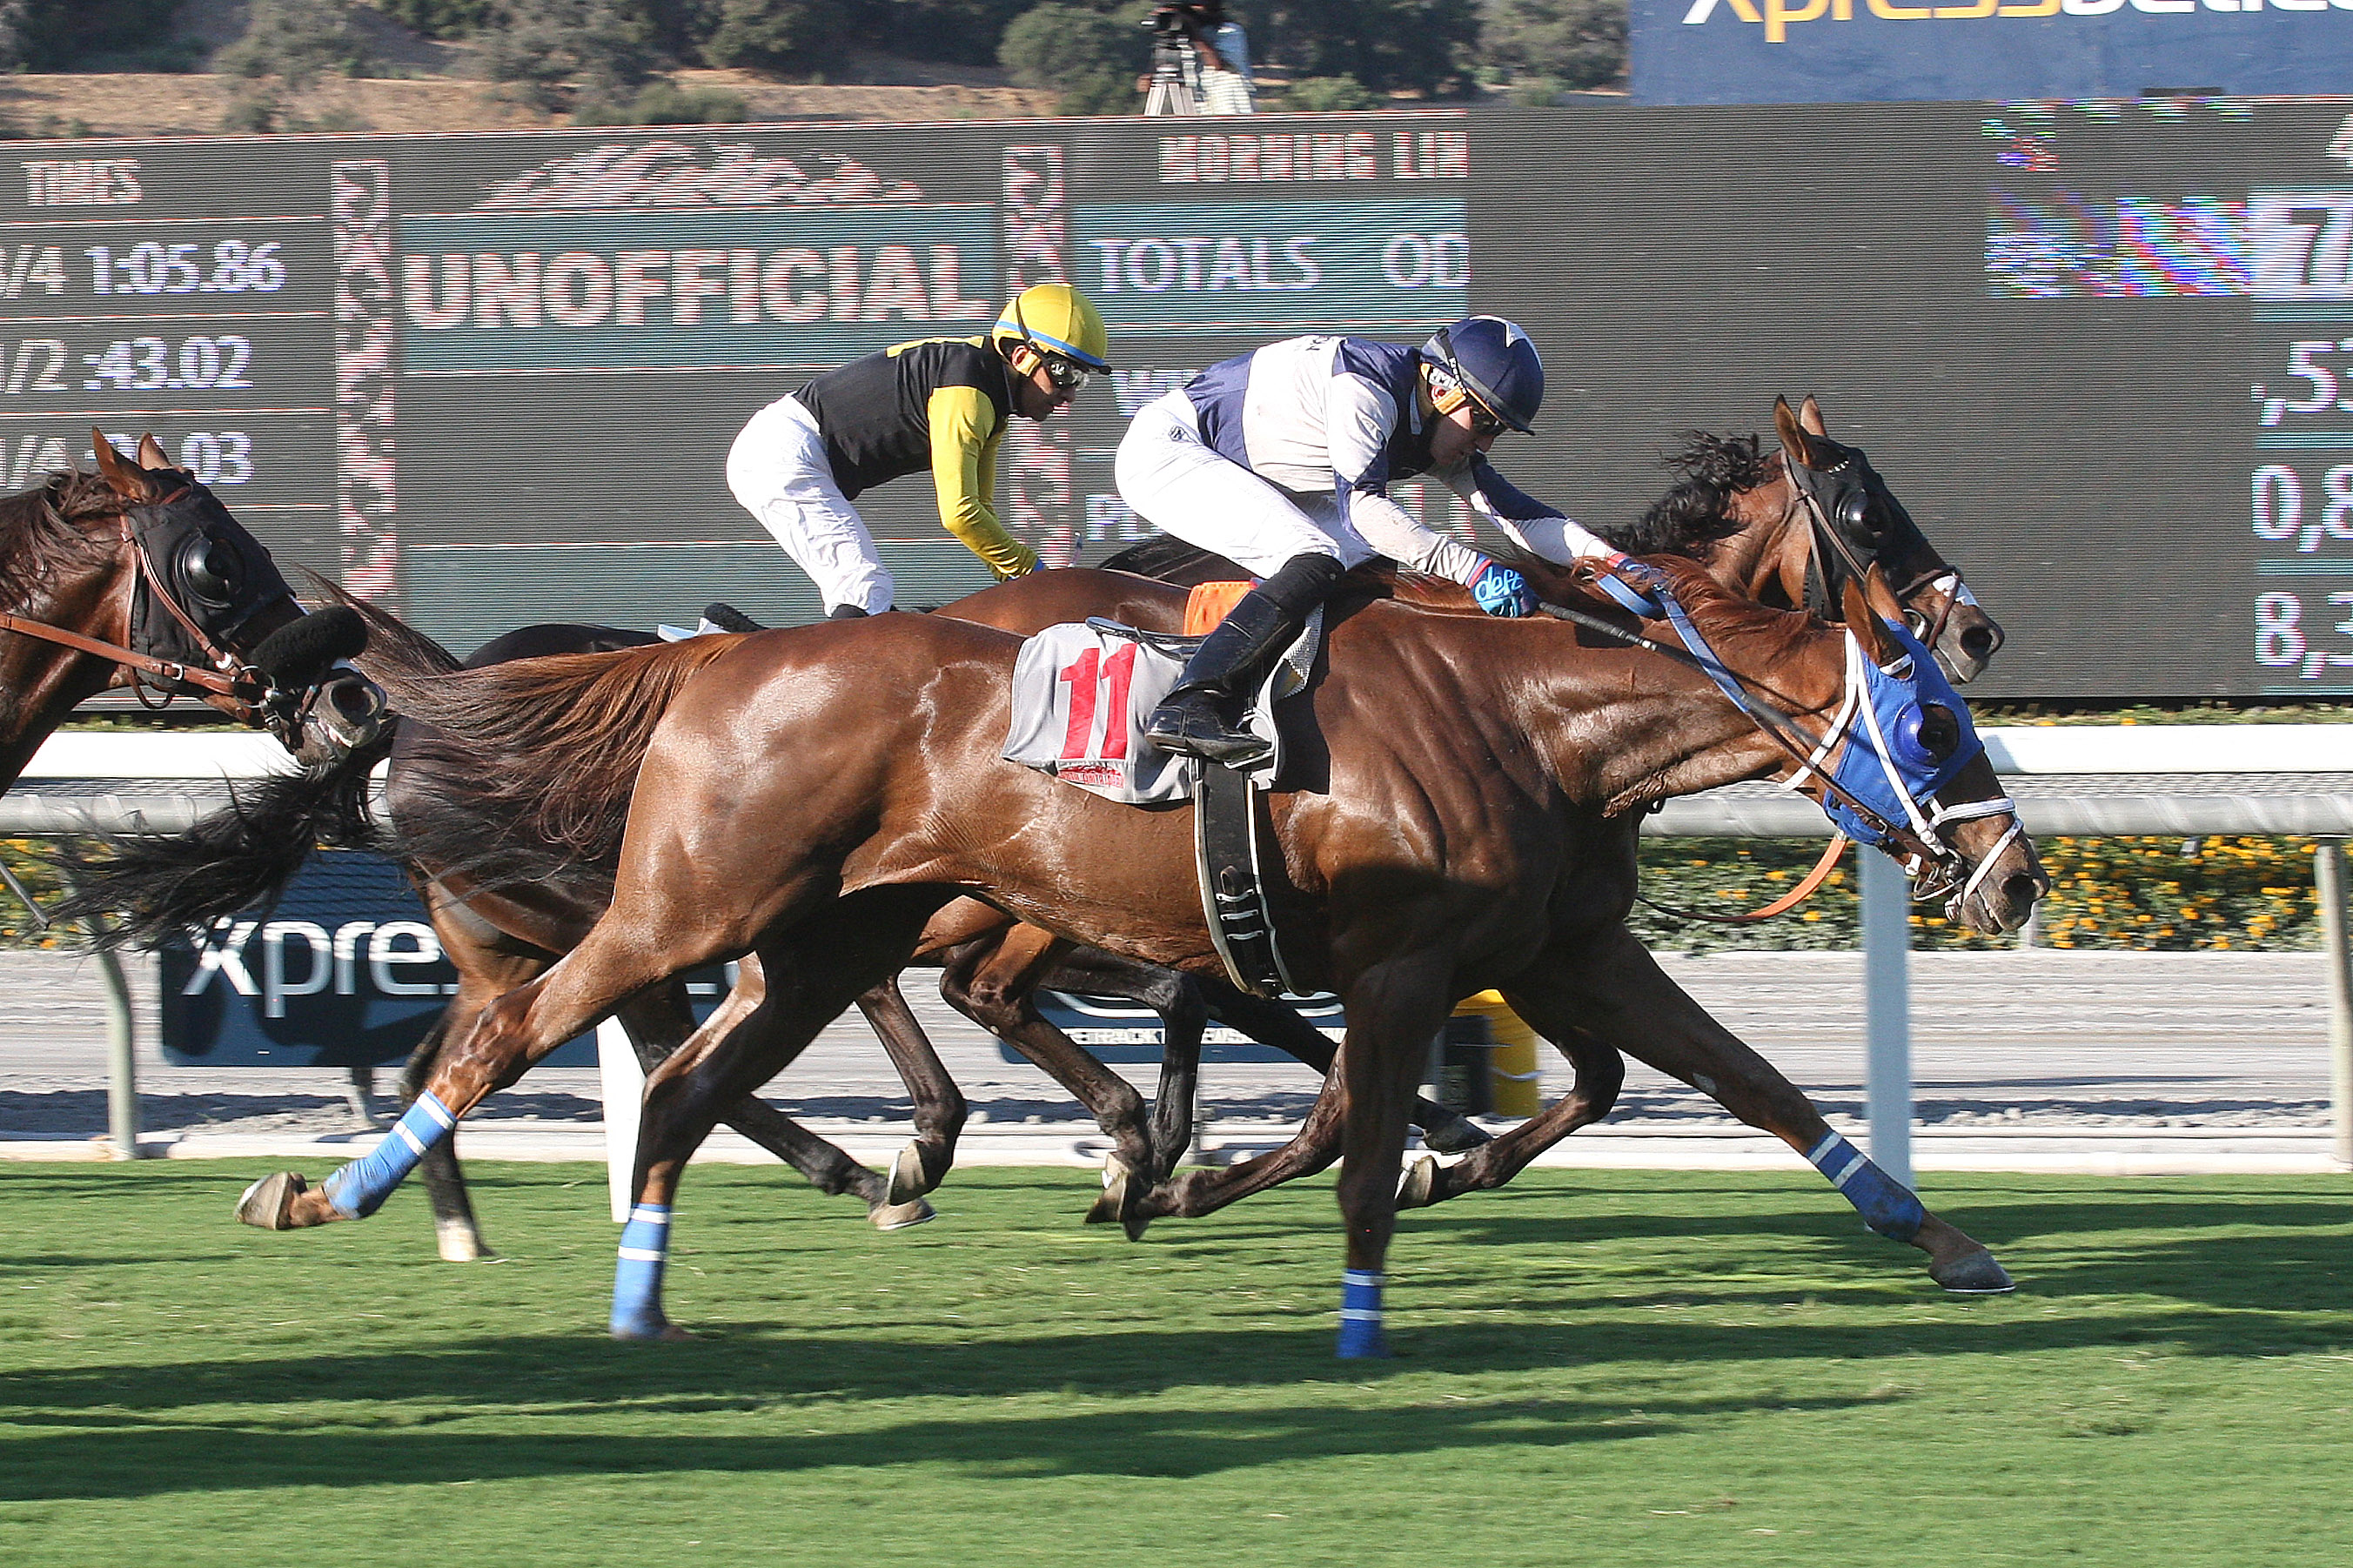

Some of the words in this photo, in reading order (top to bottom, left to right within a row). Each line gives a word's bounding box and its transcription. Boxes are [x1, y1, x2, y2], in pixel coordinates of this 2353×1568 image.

[1158, 132, 1376, 183] MORNING
[83, 239, 287, 295] 1:05.86
[401, 245, 992, 329] UNOFFICIAL
[1087, 234, 1322, 293] TOTALS
[82, 335, 255, 391] :43.02
[1473, 566, 1524, 602] deft
[1059, 642, 1138, 761] 11
[179, 915, 459, 1019] xpre
